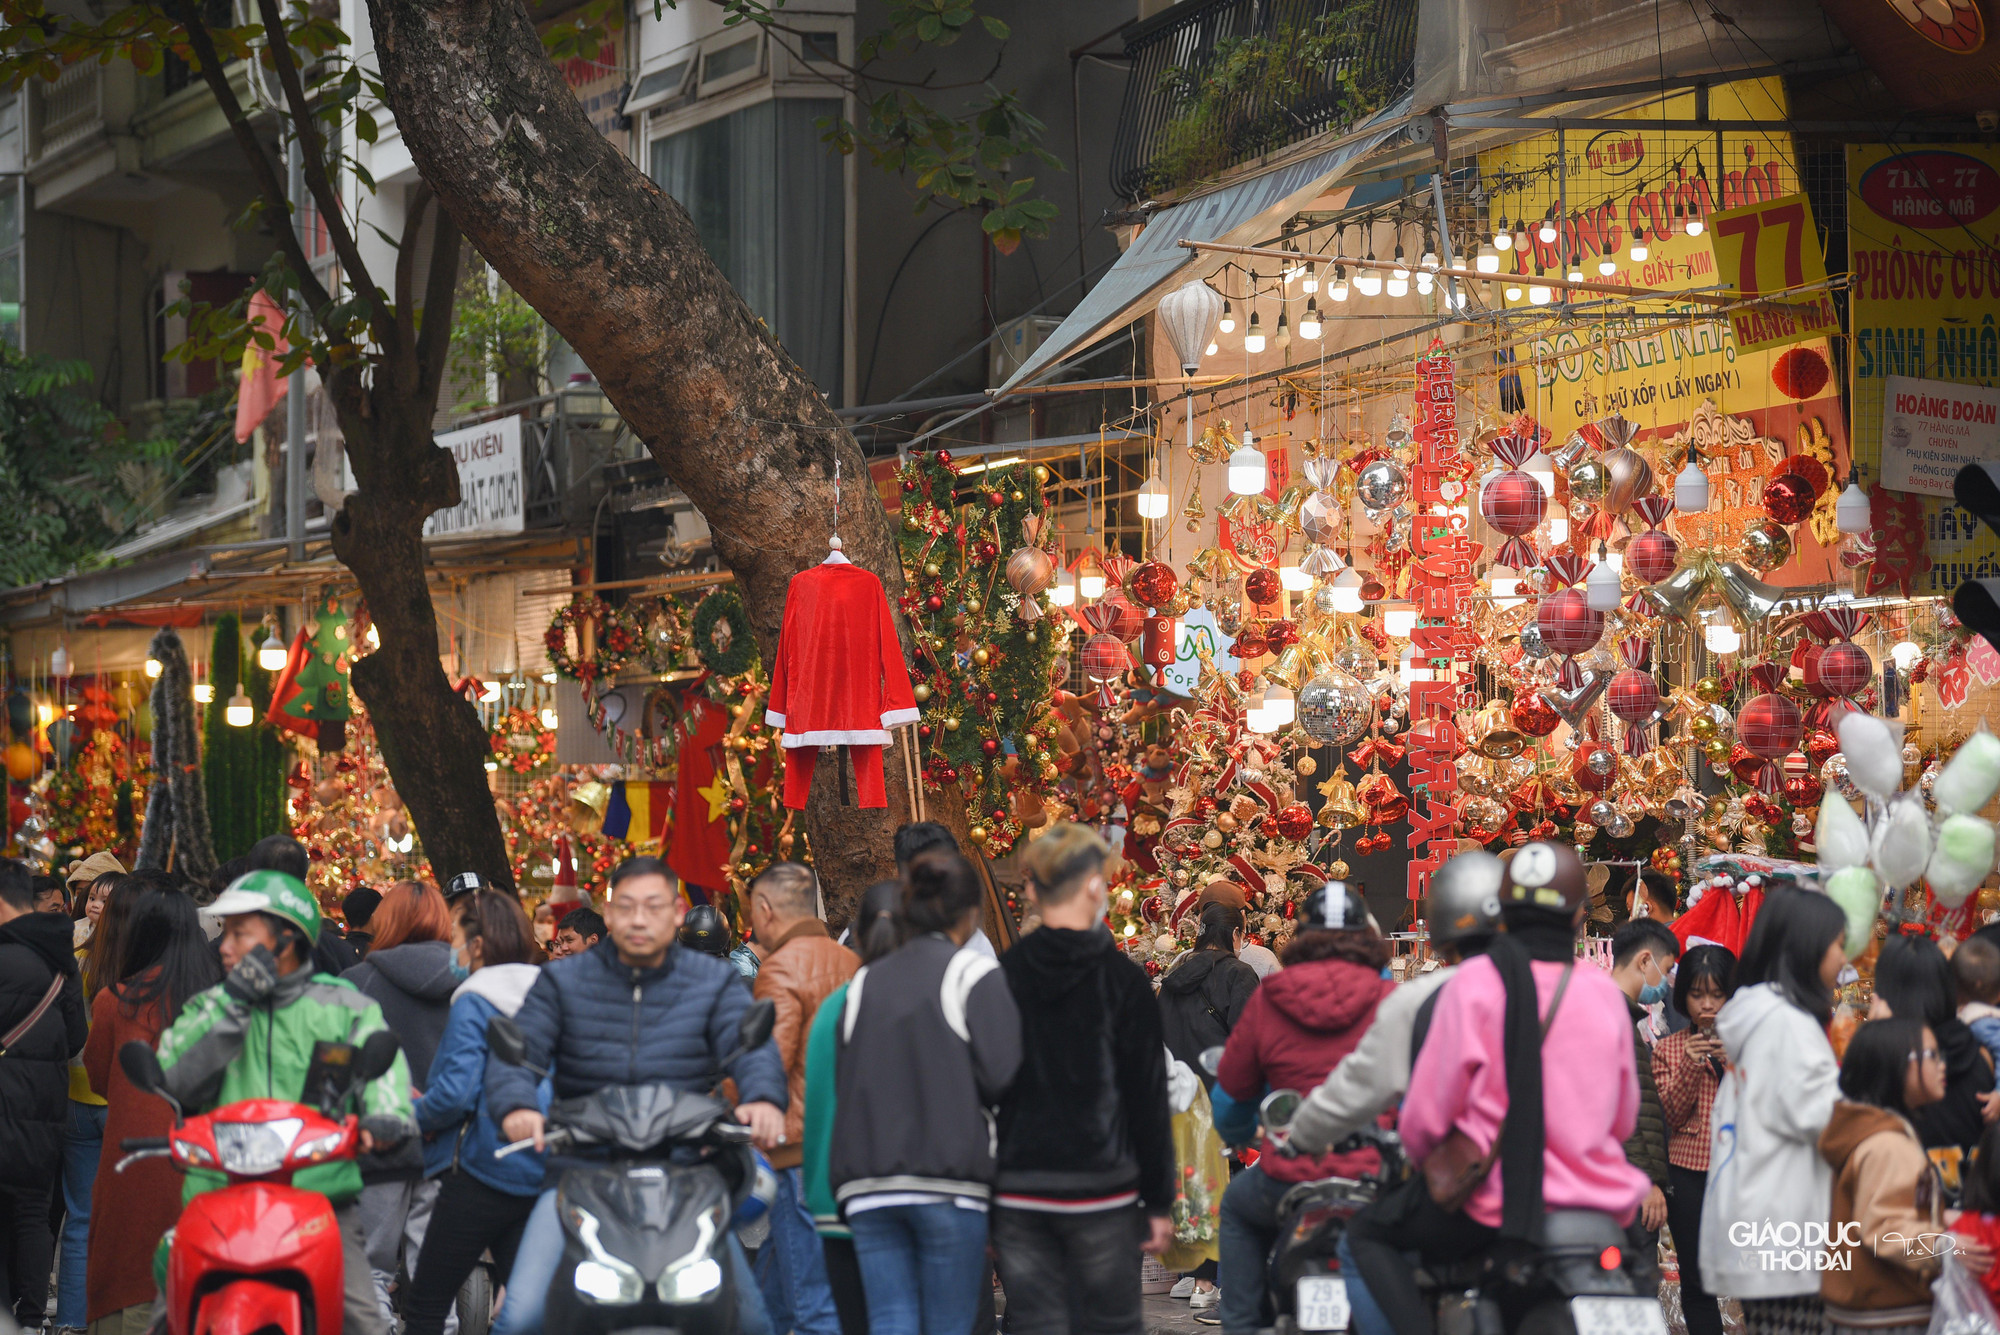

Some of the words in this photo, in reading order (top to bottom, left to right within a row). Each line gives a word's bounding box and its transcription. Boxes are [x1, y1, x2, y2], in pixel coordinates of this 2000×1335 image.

[1887, 168, 1930, 188] 71A
[1954, 168, 1980, 188] 77
[1892, 195, 1943, 216] HÀNG
[1949, 195, 1976, 216] MÃ
[1716, 201, 1806, 301] 77
[1642, 250, 1674, 287] GIẤY
[1685, 250, 1713, 277] KIM
[1854, 233, 1944, 300] PHÔNG
[1951, 233, 2000, 300] CƯỚ
[1857, 327, 1925, 379] SINH
[1937, 313, 2000, 388] NHẬ
[1630, 378, 1657, 407] XỐP
[1695, 370, 1731, 394] NGAY
[1895, 393, 1949, 419] HOÀNG
[1952, 400, 1997, 425] ĐOÀN
[1918, 420, 1928, 431] 77
[1929, 421, 1955, 435] HÀNG
[470, 430, 503, 463] KIỆN
[1928, 436, 1958, 449] CHUYÊN
[1906, 448, 1921, 459] PHỤ
[1922, 449, 1940, 461] KIỆN
[1940, 452, 1959, 463] SINH
[1912, 463, 1939, 476] PHÔNG
[1929, 479, 1943, 490] Bay
